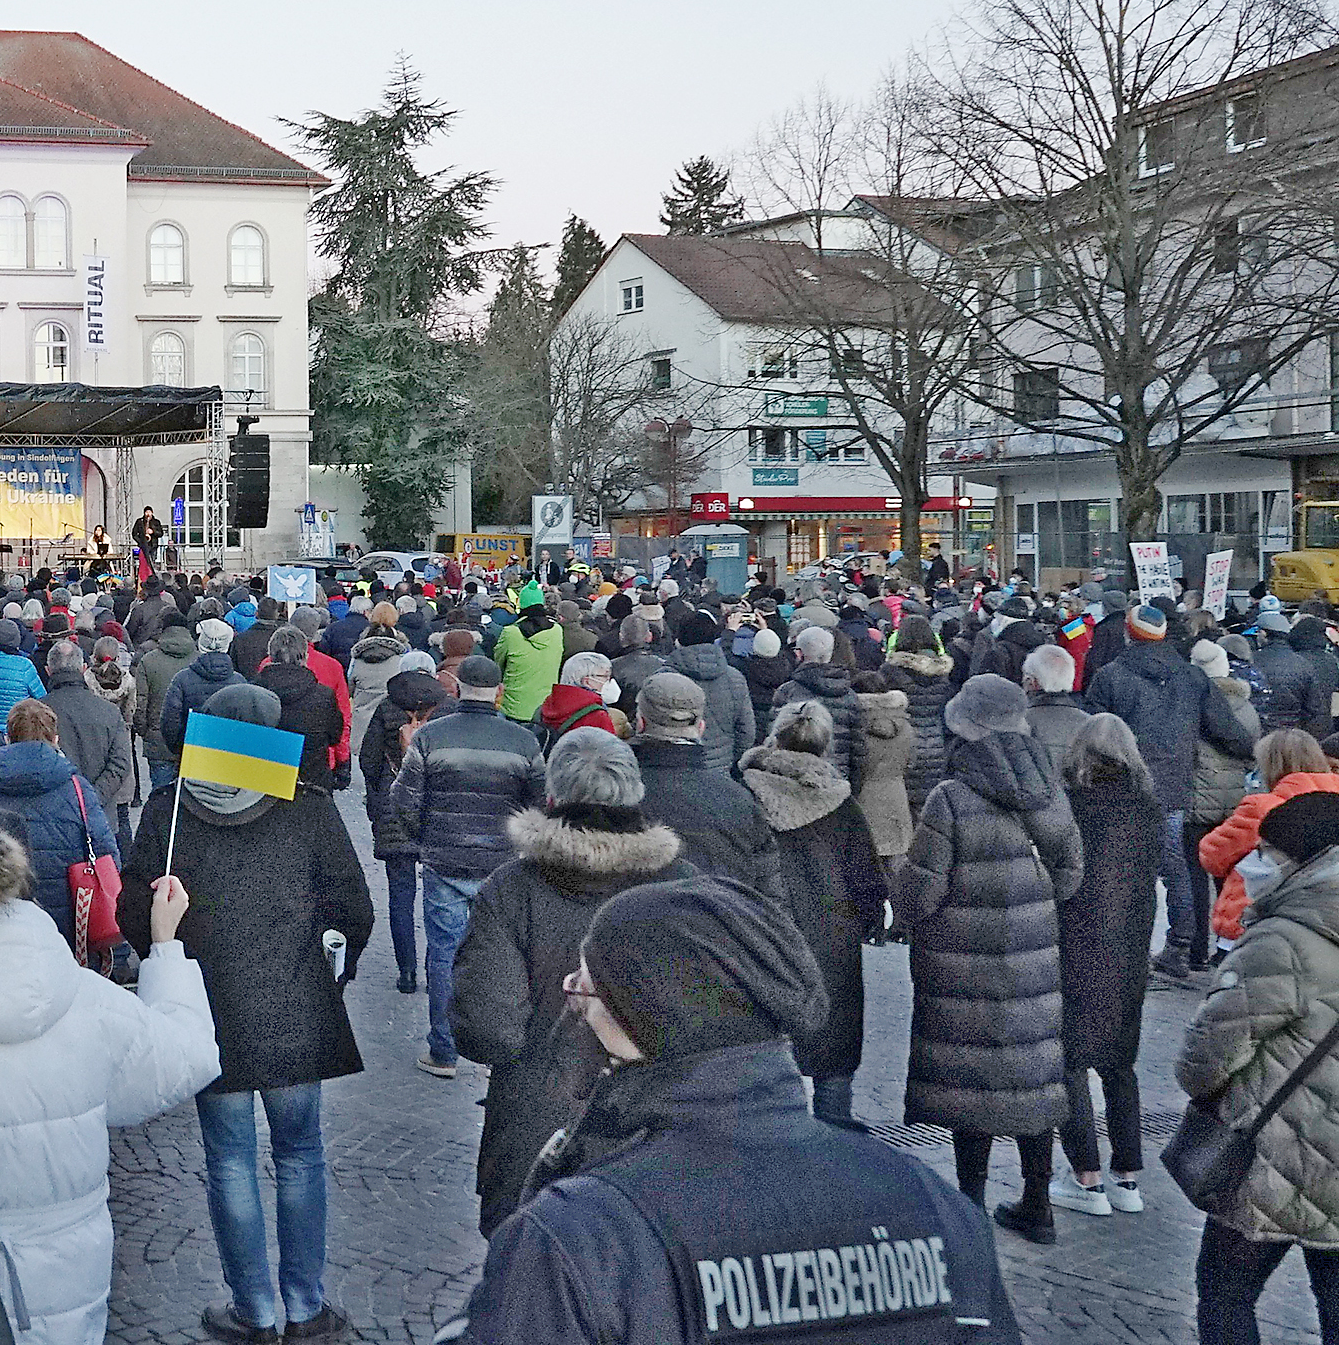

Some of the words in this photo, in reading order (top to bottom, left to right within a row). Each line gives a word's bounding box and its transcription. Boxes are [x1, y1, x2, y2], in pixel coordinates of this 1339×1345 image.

[87, 260, 104, 343] RITUAL
[17, 453, 25, 461] in
[44, 469, 69, 484] für
[6, 490, 76, 505] Ukraine
[697, 1226, 952, 1332] POLIZEIBEHÖRDE
